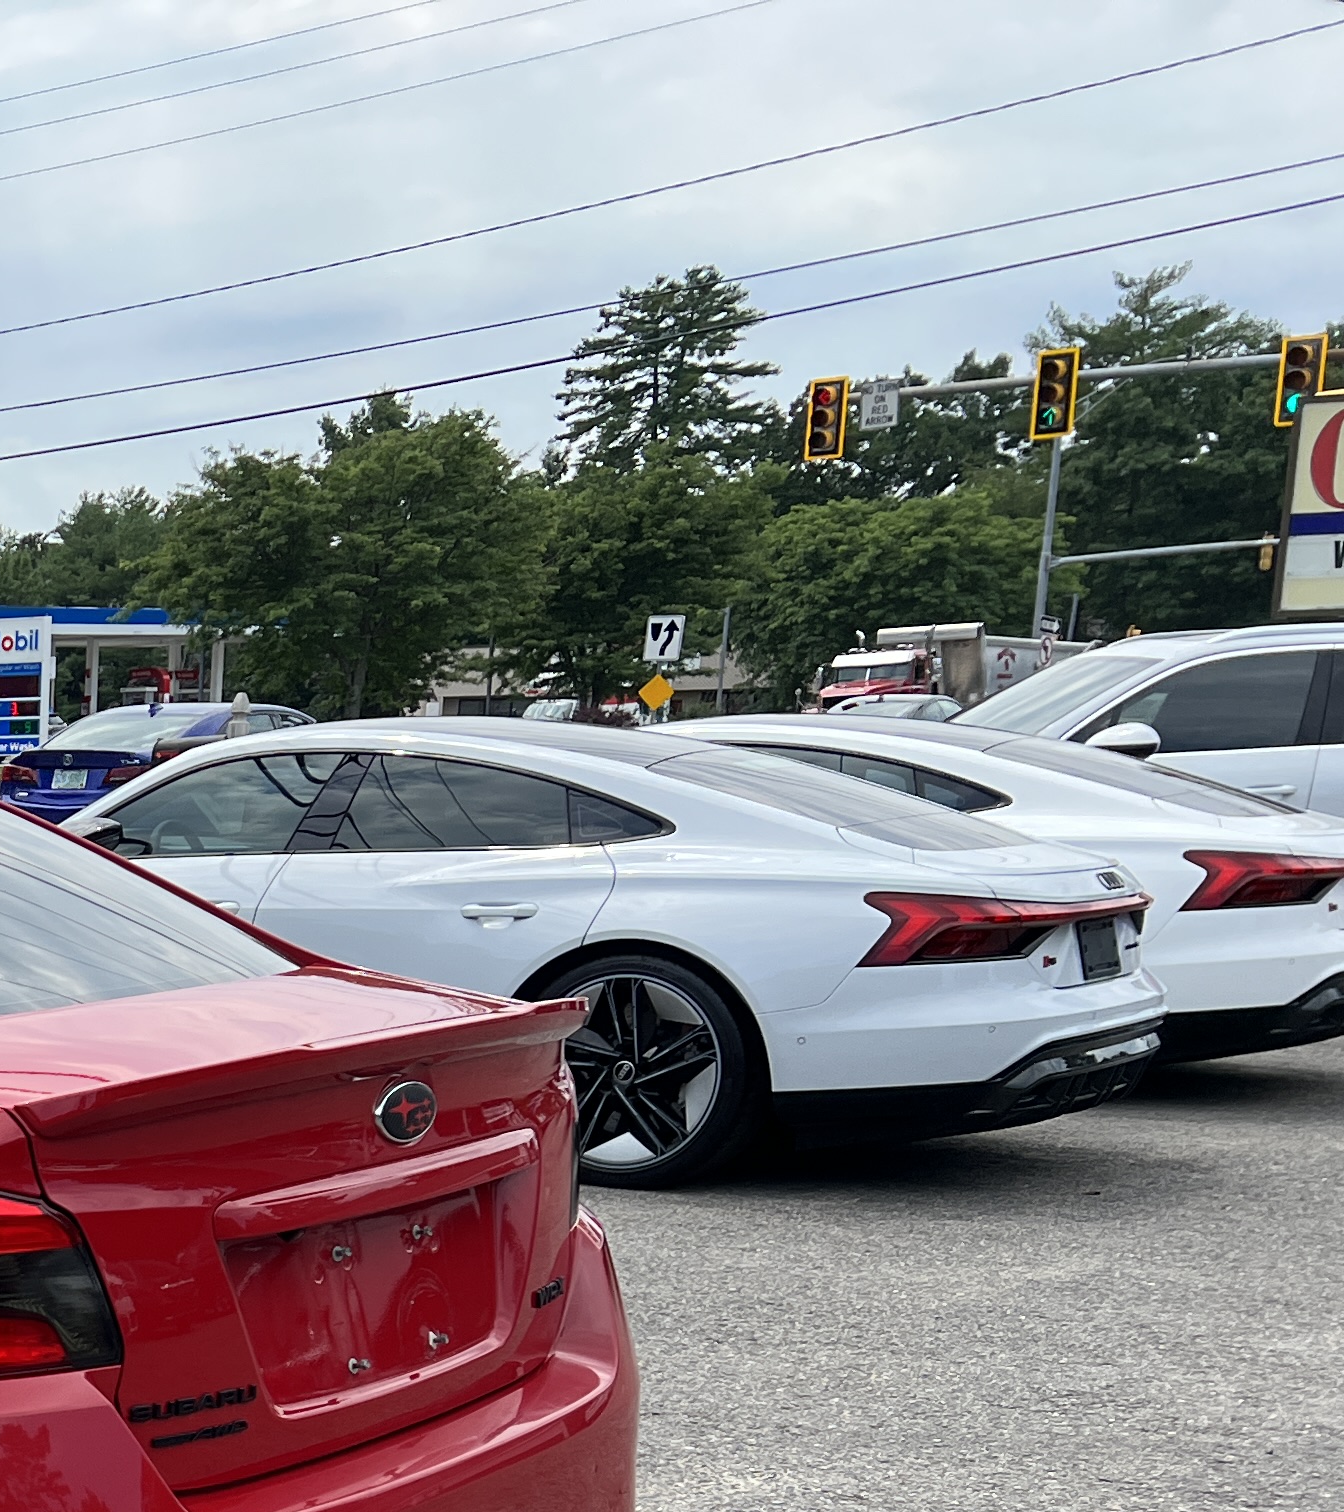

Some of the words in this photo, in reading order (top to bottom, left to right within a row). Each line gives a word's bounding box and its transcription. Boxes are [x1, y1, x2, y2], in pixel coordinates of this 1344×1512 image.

[874, 395, 886, 404] ON
[871, 404, 888, 414] RED
[865, 414, 894, 426] ARROW
[9, 741, 36, 752] Wash
[532, 1276, 564, 1308] WRX
[129, 1384, 257, 1422] SUBARU
